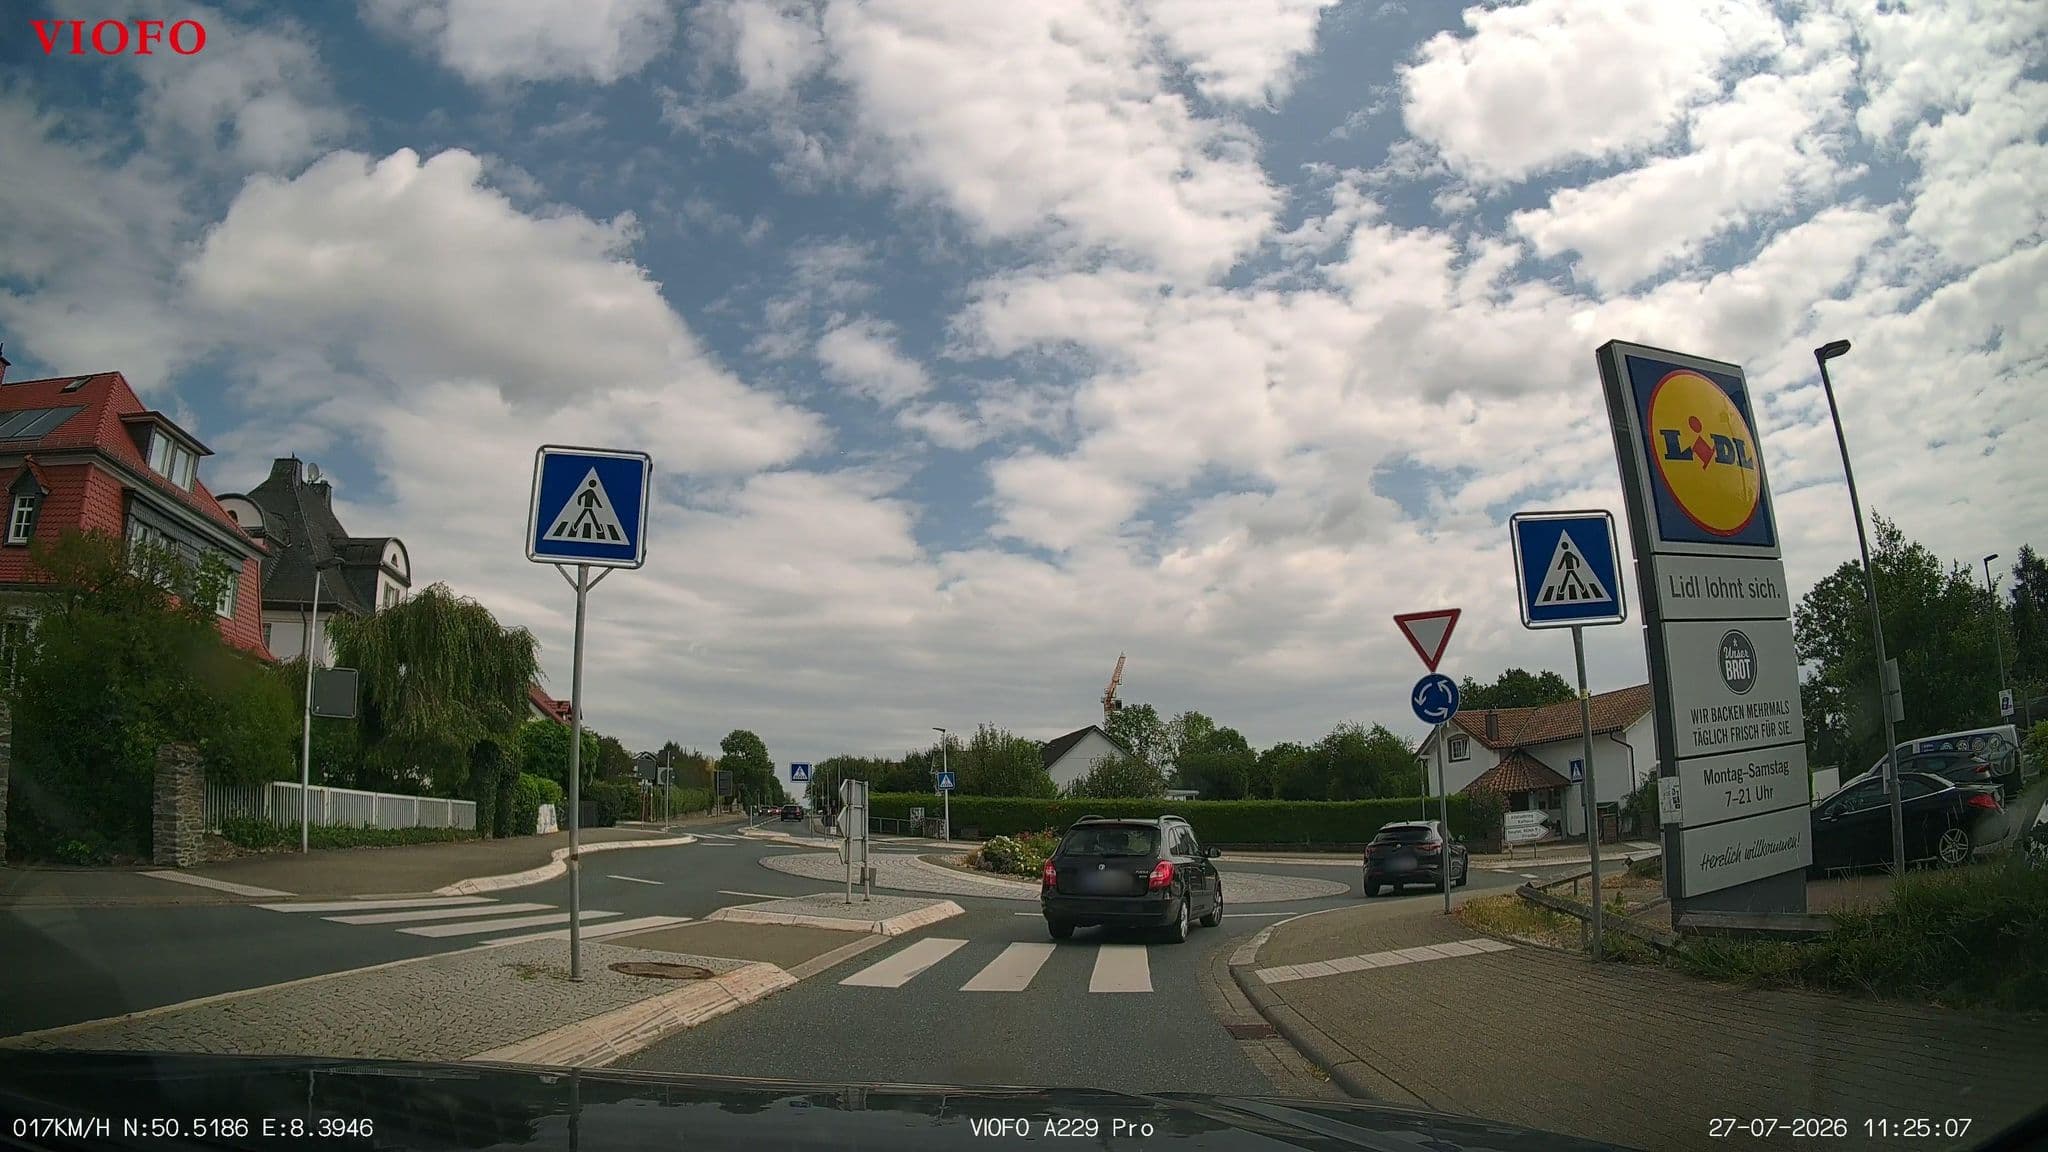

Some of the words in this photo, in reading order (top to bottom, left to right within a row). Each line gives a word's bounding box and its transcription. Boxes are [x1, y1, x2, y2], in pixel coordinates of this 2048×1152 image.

[1669, 575, 1700, 598] Lidl
[1704, 576, 1745, 599] lohnt
[1748, 577, 1781, 599] sich.
[1725, 659, 1751, 681] BROT
[1690, 708, 1709, 725] WIR
[1711, 704, 1745, 723] BACKEN
[1746, 700, 1790, 719] MEHRMALS
[1693, 727, 1728, 747] TÄGLICH
[1730, 723, 1760, 743] FRISCH
[1761, 720, 1777, 738] FÜR
[1777, 720, 1793, 736] SIE.
[1755, 784, 1774, 802] Uhr
[1699, 841, 1741, 872] Herzlich
[1743, 832, 1801, 861] willkommen!
